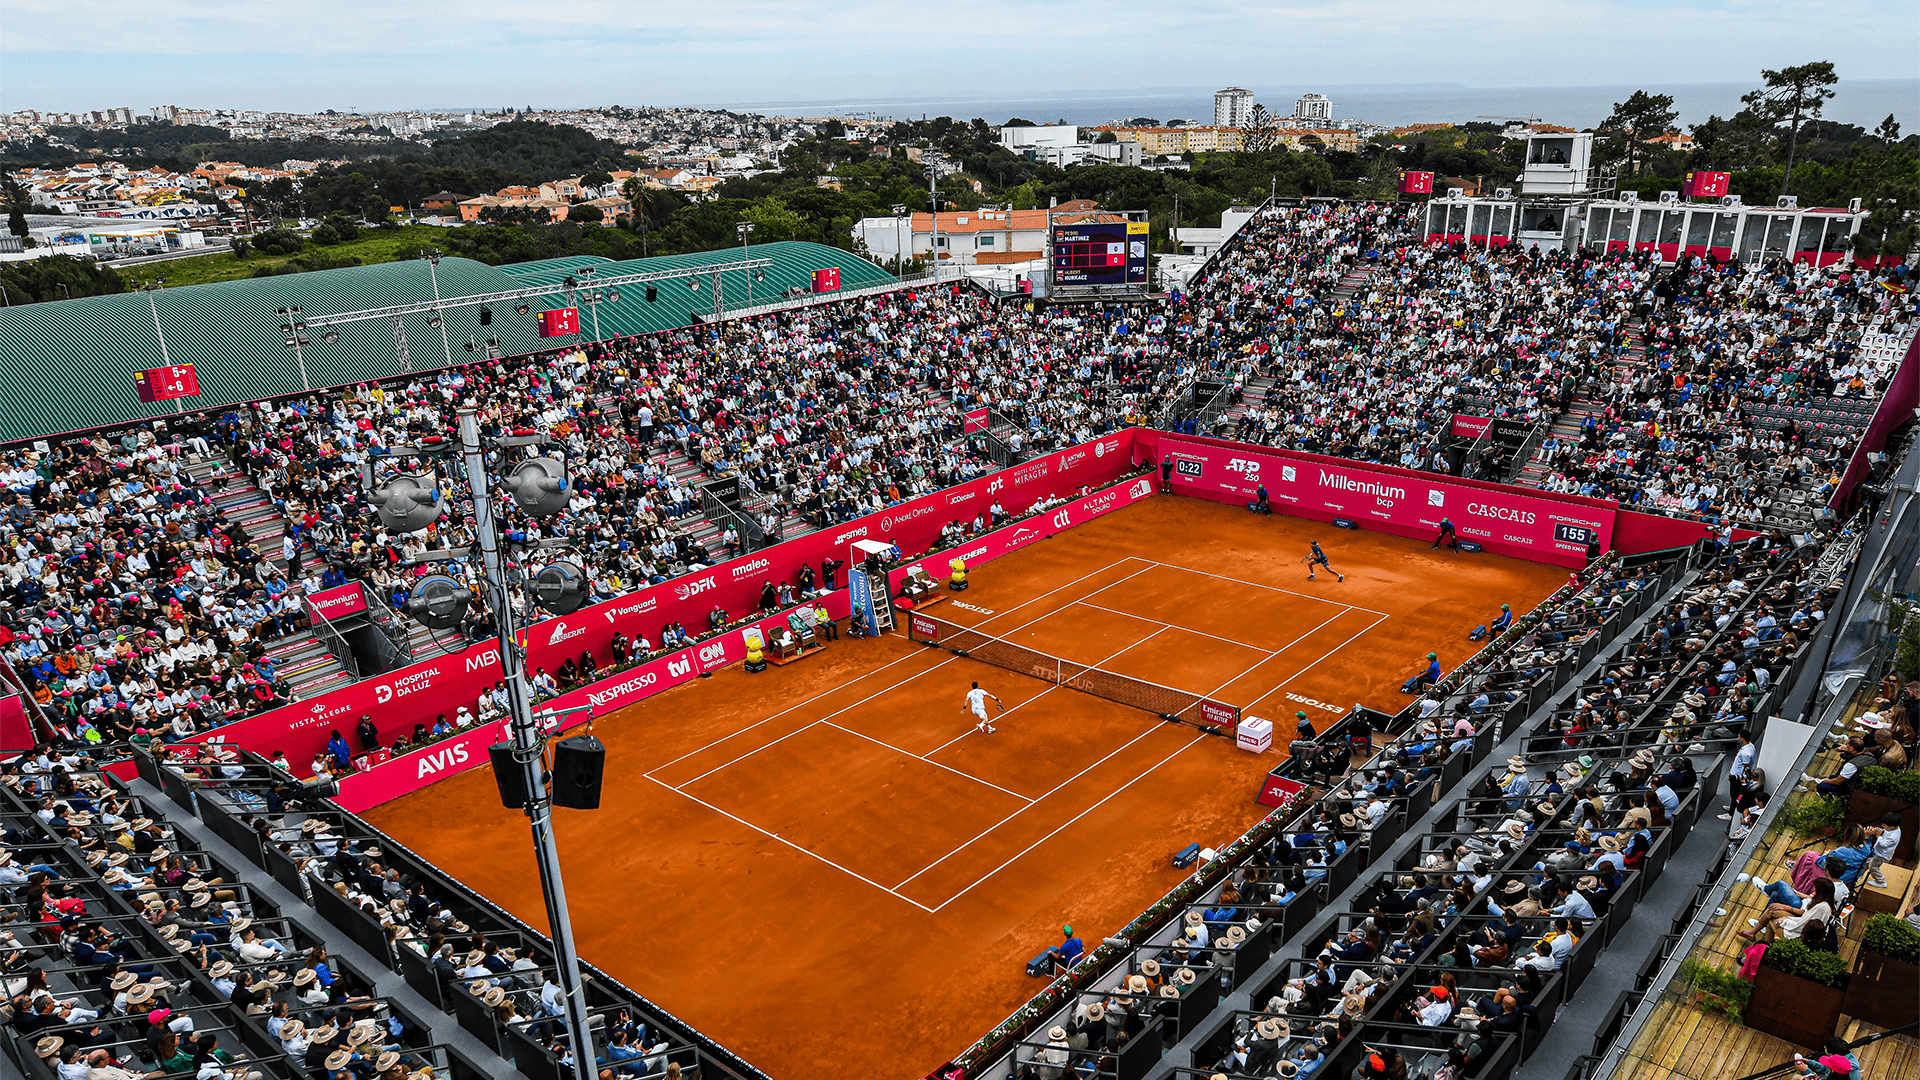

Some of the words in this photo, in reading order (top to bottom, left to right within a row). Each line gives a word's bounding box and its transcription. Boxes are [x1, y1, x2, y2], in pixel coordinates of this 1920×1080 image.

[1713, 173, 1718, 182] 1
[1710, 183, 1717, 193] 2
[1061, 258, 1066, 266] 4
[1113, 256, 1118, 264] 0
[563, 309, 568, 319] 4
[563, 320, 569, 330] 5
[171, 366, 180, 378] 5
[175, 380, 184, 392] 6
[1497, 427, 1530, 438] CASCAIS
[1171, 451, 1208, 462] PORSCHE
[1013, 467, 1028, 478] HOTEL
[1028, 461, 1047, 473] CASCAIS
[1178, 461, 1201, 475] 0:22
[1224, 457, 1260, 475] ATP
[1014, 468, 1048, 486] MIRAGEM
[1244, 473, 1260, 483] 250
[1318, 468, 1405, 500] Millennium
[987, 476, 1004, 496] .pt
[950, 492, 975, 505] JCDecaux
[1083, 491, 1116, 511] ALTANO
[1376, 496, 1394, 509] bcp
[893, 512, 912, 525] ANDRÉ
[912, 505, 934, 518] OPTICAS
[1092, 503, 1111, 515] DOURO
[1467, 502, 1536, 525] CASCAIS
[1053, 508, 1071, 529] ctt
[1549, 514, 1602, 528] PORSCHE
[845, 526, 868, 541] smeg
[1005, 530, 1040, 548] AZIMUT
[1462, 526, 1492, 538] CASCAIS
[1503, 534, 1533, 545] CASCAIS
[1561, 527, 1586, 541] 155
[1555, 542, 1571, 551] SPEED
[948, 545, 988, 567] SKECHERS
[689, 575, 717, 596] DFK
[311, 592, 359, 610] Millennium
[617, 597, 657, 616] Vanguard
[951, 599, 994, 616] ESTORIL
[699, 641, 725, 662] CNN
[667, 654, 692, 678] tvi
[703, 657, 727, 669] PORTUGAL
[394, 667, 441, 689] HOSPITAL
[1029, 664, 1058, 680] ATP
[1059, 672, 1095, 693] TOUR
[397, 686, 412, 698] DA
[413, 679, 432, 695] LUZ
[585, 672, 657, 706] NESPRESSO
[1285, 691, 1345, 714] ESTORIL
[289, 717, 316, 730] VISTA
[318, 704, 352, 721] ALEGRE
[1202, 704, 1233, 719] Emirates
[1213, 714, 1228, 724] BETTER
[1240, 736, 1257, 745] Betclic
[379, 753, 386, 761] 2
[418, 742, 470, 780] AVIS
